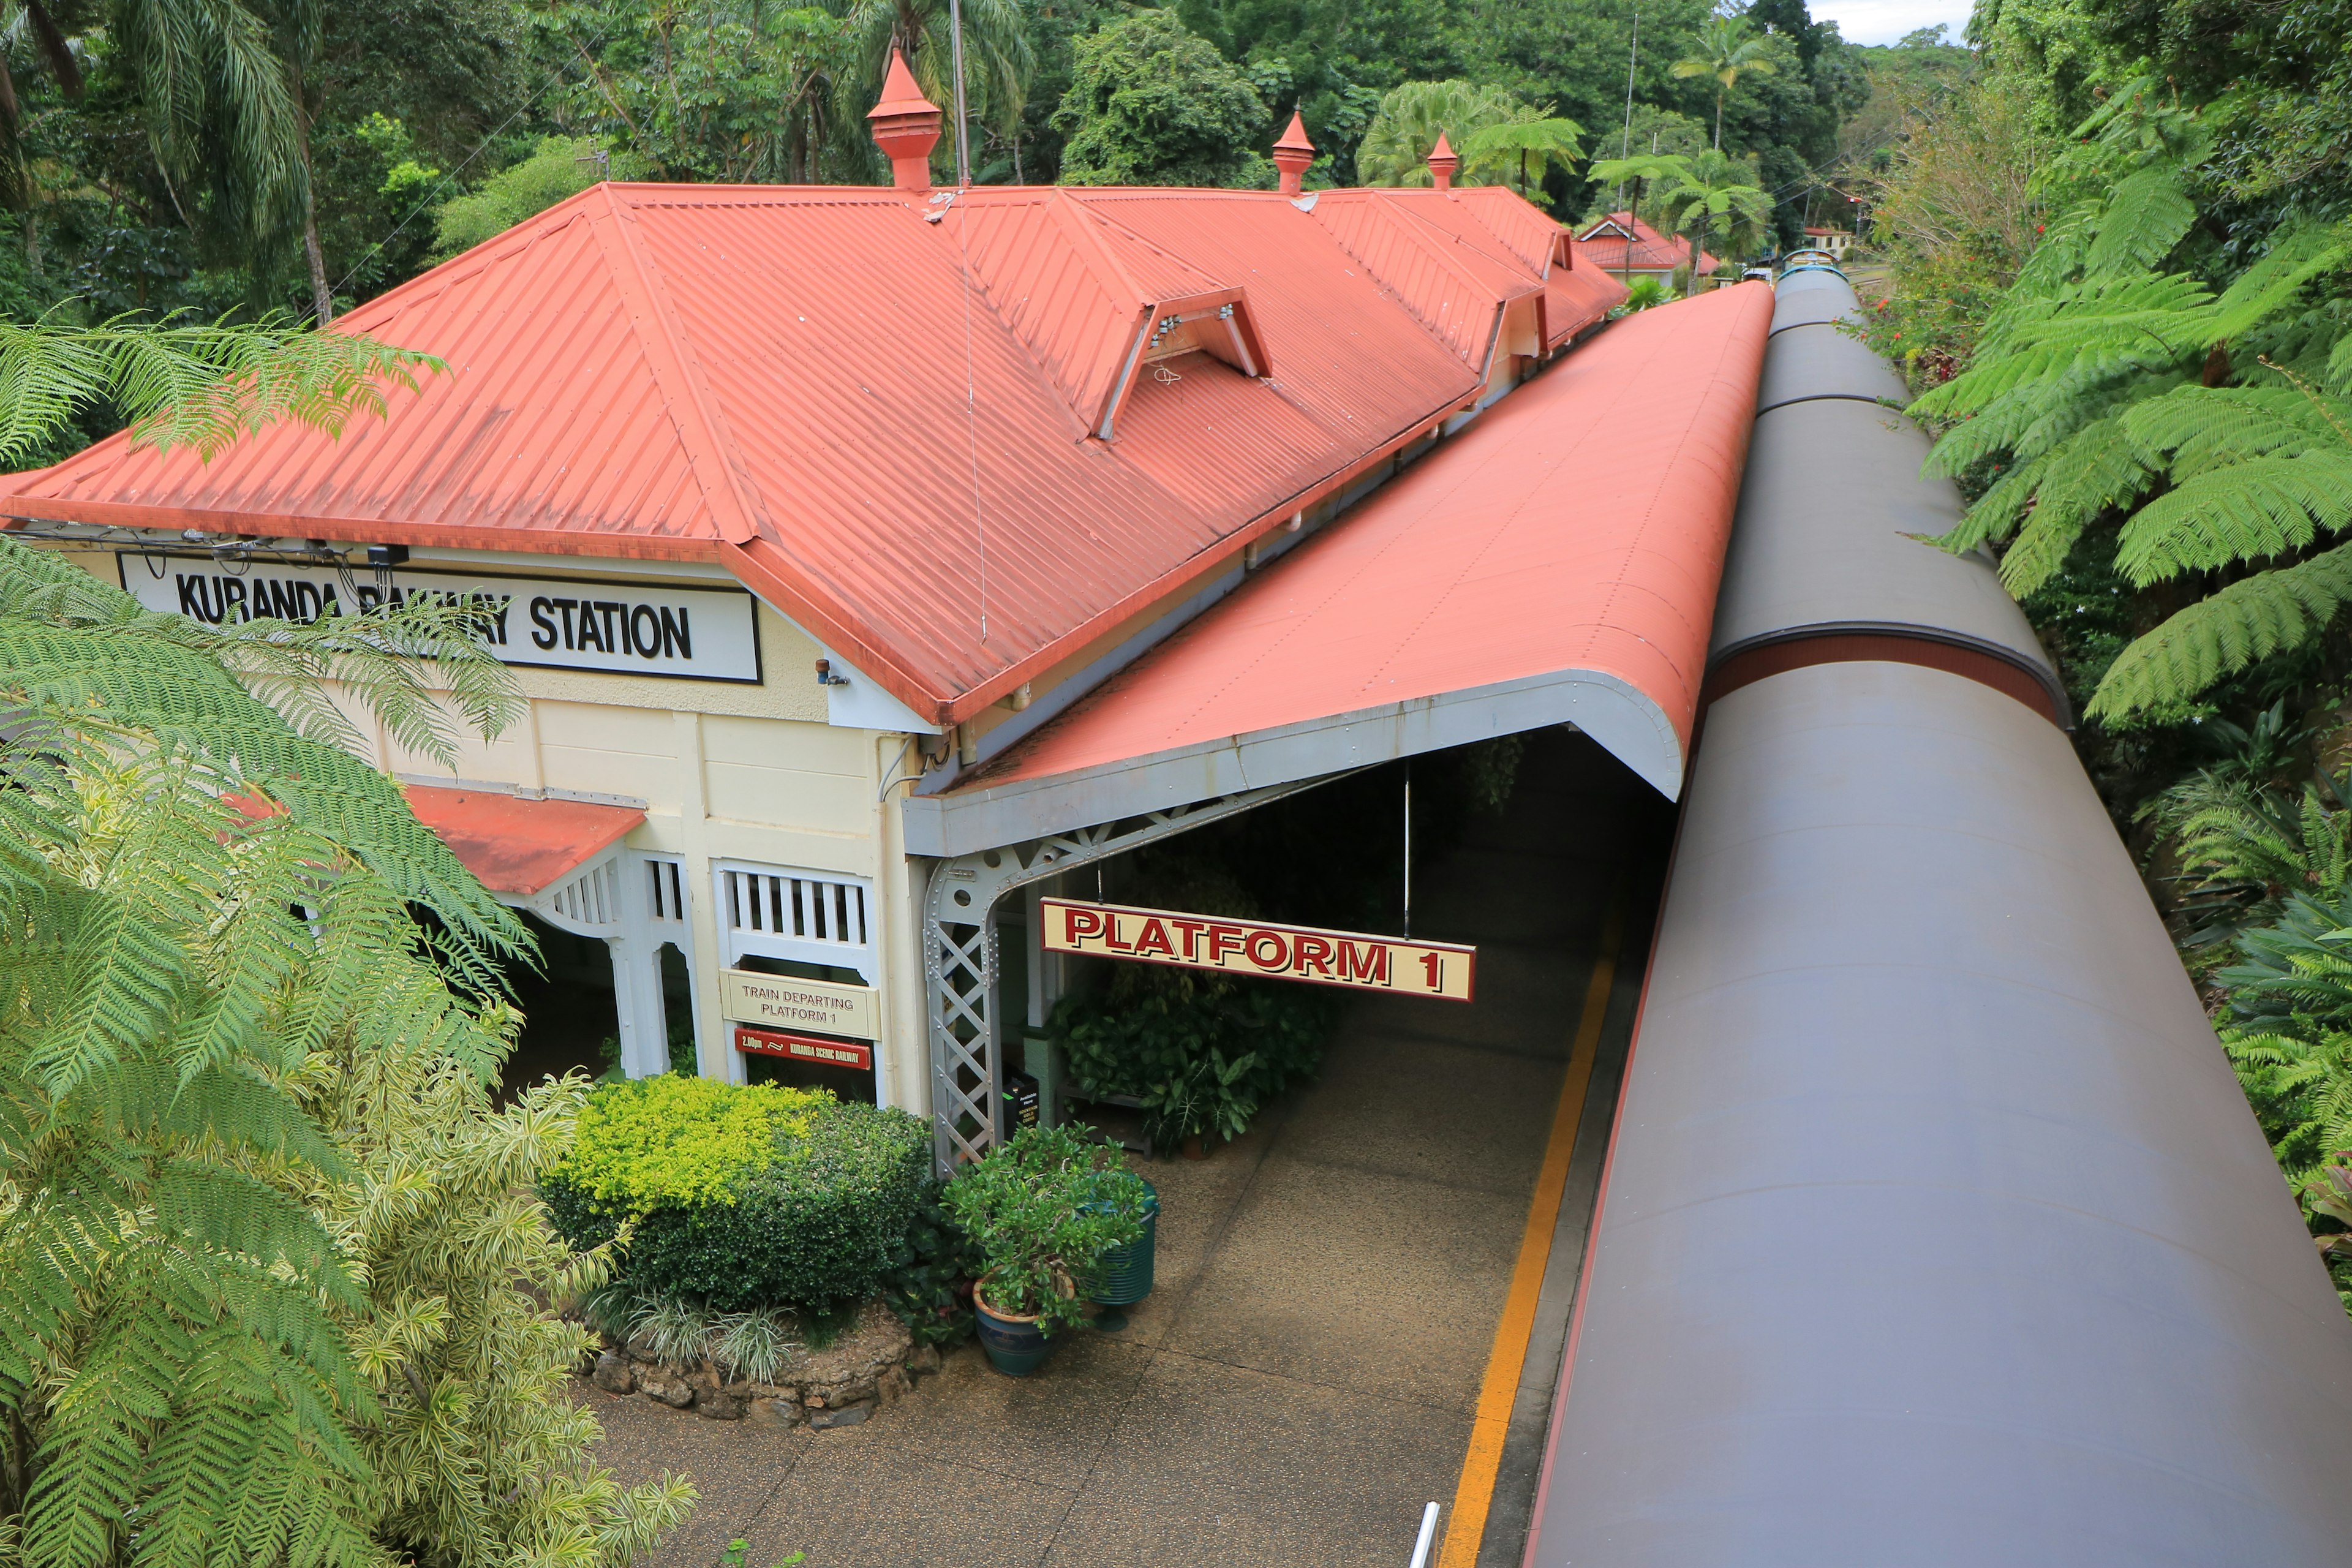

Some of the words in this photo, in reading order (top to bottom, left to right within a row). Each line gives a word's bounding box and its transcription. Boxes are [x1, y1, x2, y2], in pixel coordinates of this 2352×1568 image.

[176, 574, 342, 626] KURANDA
[530, 596, 692, 659] STATION
[1064, 908, 1391, 986] PLATFORM
[1419, 952, 1443, 993] 1
[742, 985, 779, 1000] TRAIN
[783, 991, 853, 1011] DEPARTING
[761, 1003, 827, 1023] PLATFORM
[830, 1013, 836, 1024] 1
[742, 1036, 763, 1049] 2.00pm
[815, 1047, 835, 1060] SCENIC
[835, 1050, 859, 1063] RAILWAY
